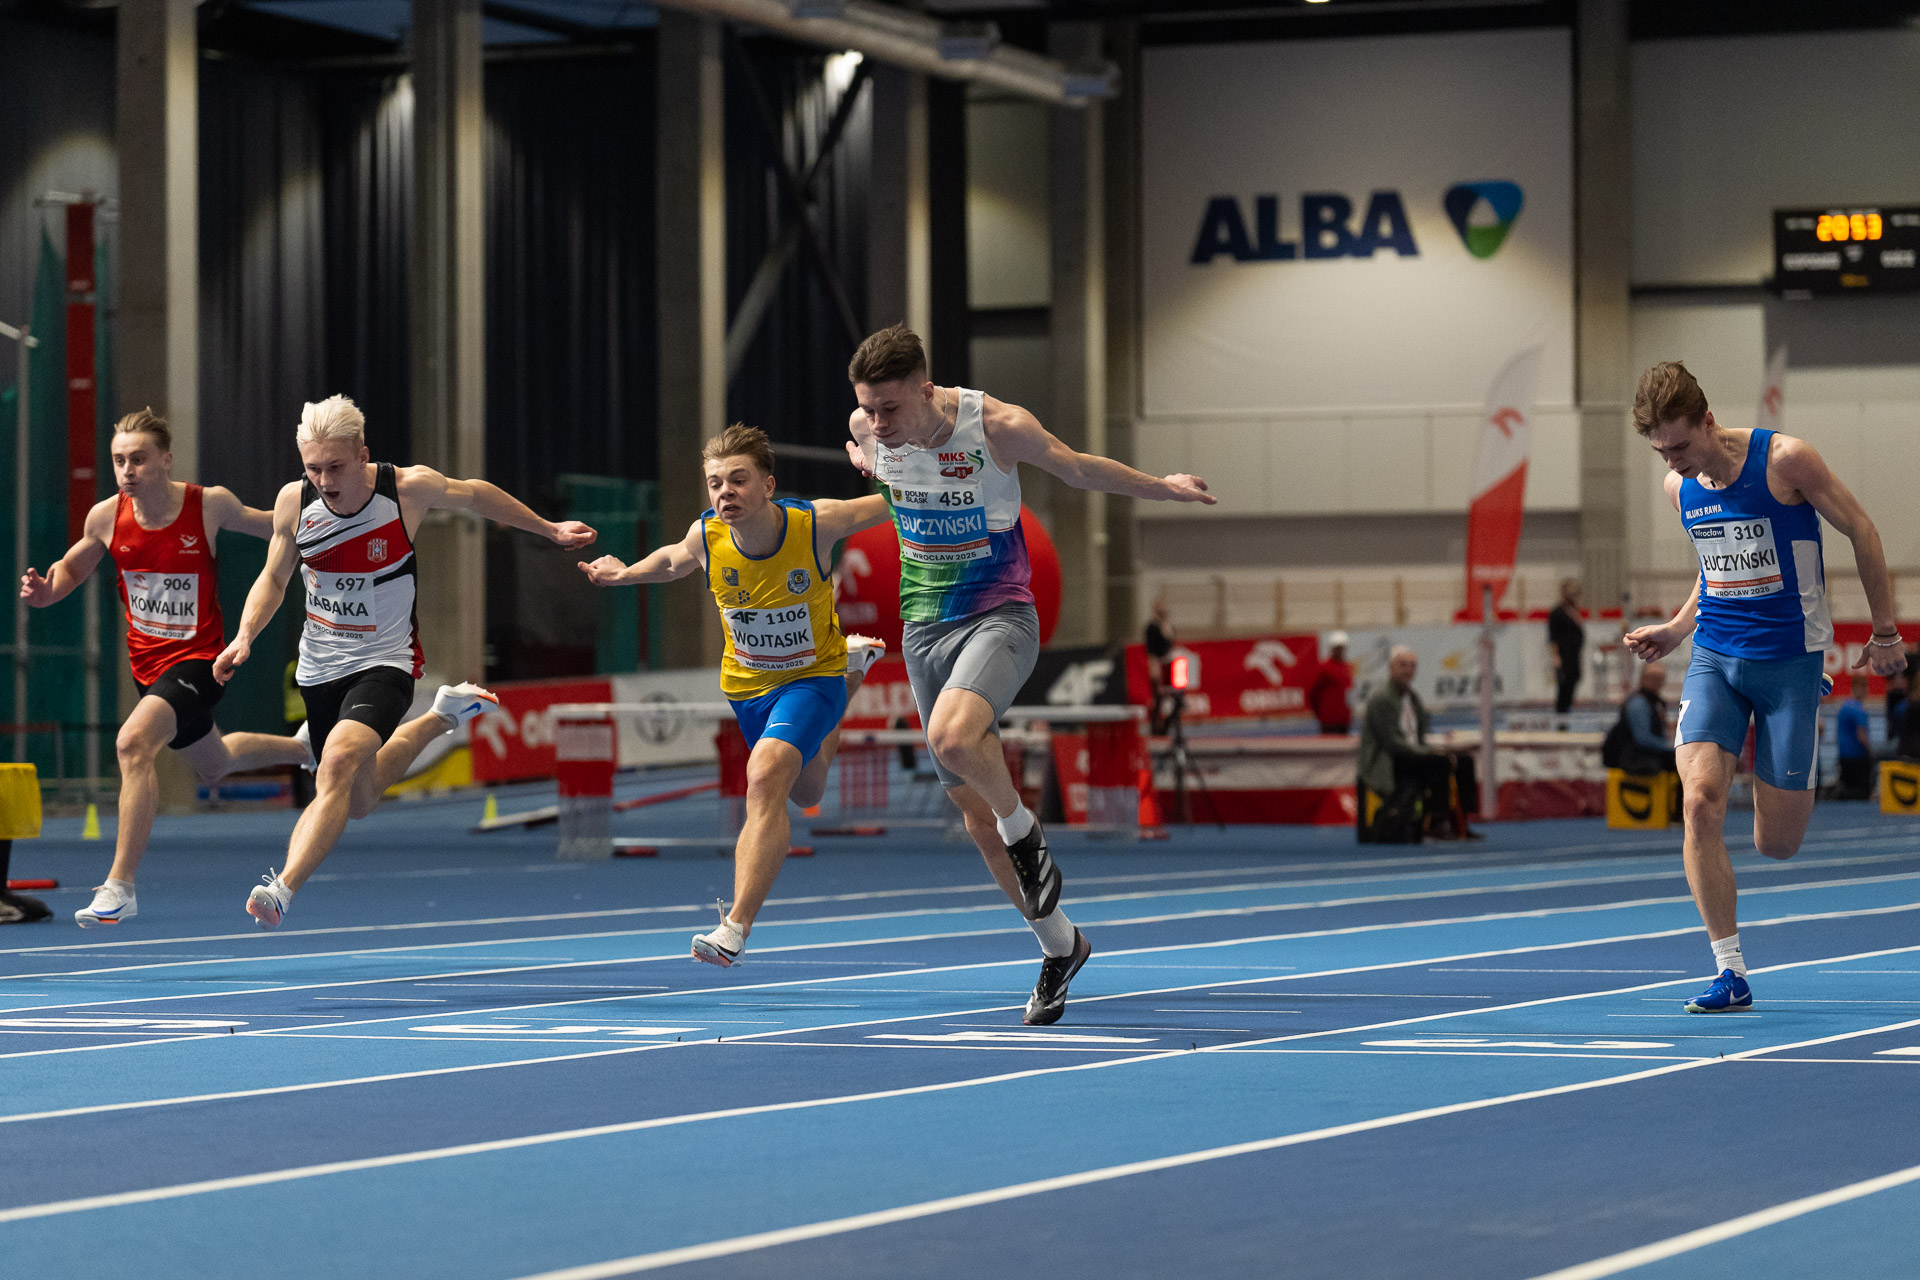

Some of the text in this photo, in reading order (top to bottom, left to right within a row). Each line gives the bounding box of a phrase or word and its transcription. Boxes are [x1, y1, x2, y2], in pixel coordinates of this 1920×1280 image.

[1190, 191, 1419, 263] ALBA
[938, 452, 965, 462] MKS
[905, 490, 928, 499] DOLNY
[939, 490, 975, 506] 458
[1704, 504, 1722, 515] RAWA
[900, 514, 982, 536] BUCZYŃSKI
[1733, 524, 1764, 541] 310
[912, 551, 977, 561] WROCŁAW 2025
[1703, 549, 1776, 572] ŁUCZYŃSKI
[163, 578, 192, 591] 906
[335, 578, 366, 591] 697
[1715, 586, 1769, 597] WROCŁAW 2025
[131, 594, 195, 616] KOWALIK
[308, 591, 369, 617] TABAKA
[730, 607, 807, 625] 4F 1106
[168, 630, 185, 638] 2025
[313, 623, 344, 637] WROCŁAW
[733, 628, 809, 648] WOJTASIK
[745, 659, 804, 669] WROCŁAW 2025
[1047, 659, 1115, 705] 4F
[408, 1024, 708, 1036] 5
[1362, 1038, 1675, 1049] 3
